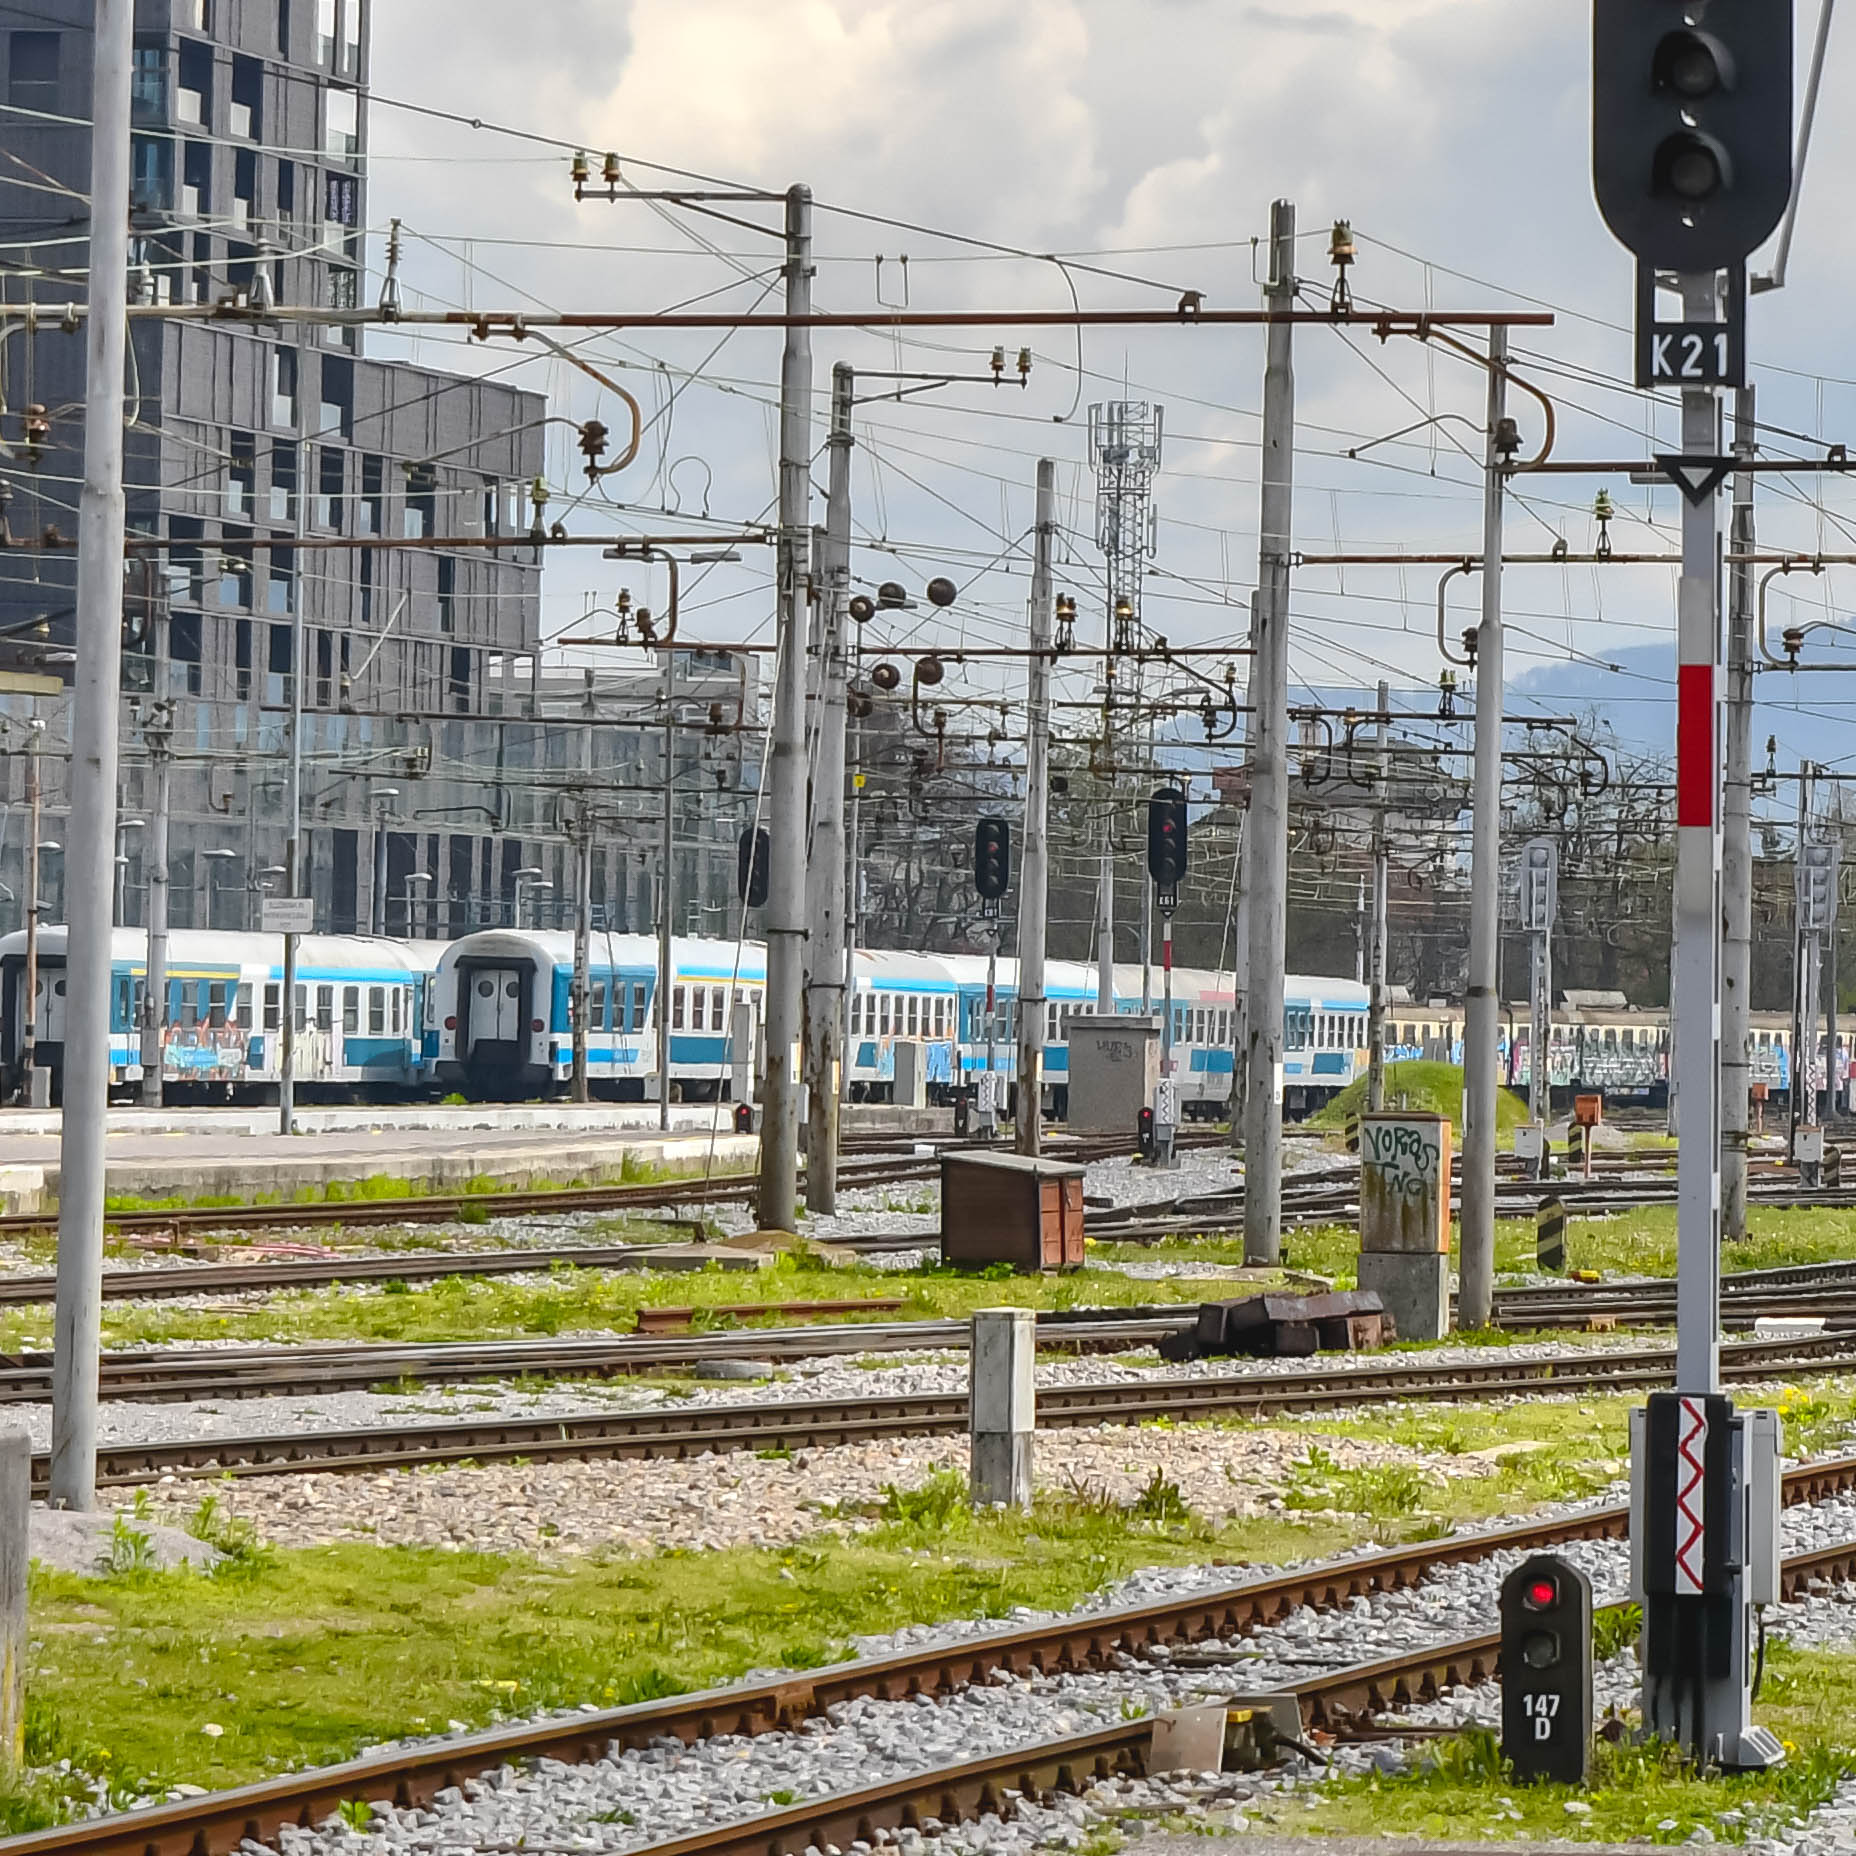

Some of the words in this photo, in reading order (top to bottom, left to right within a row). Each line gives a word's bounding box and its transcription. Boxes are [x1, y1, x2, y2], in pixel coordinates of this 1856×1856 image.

[1652, 333, 1728, 377] K21
[1523, 1694, 1561, 1717] 147
[1534, 1717, 1551, 1741] D
